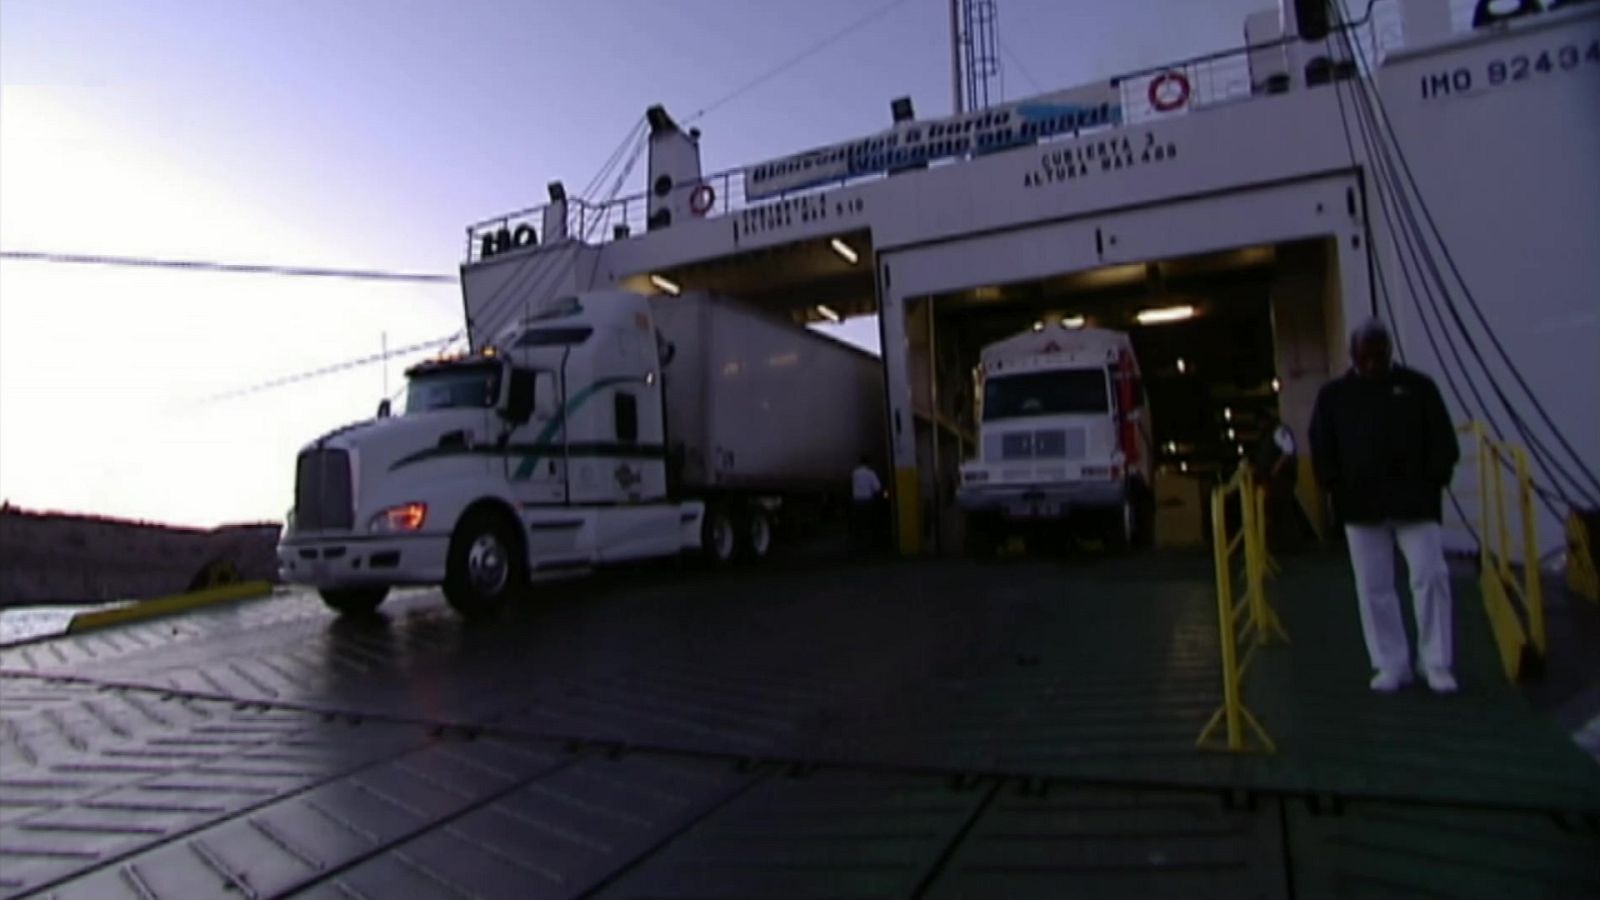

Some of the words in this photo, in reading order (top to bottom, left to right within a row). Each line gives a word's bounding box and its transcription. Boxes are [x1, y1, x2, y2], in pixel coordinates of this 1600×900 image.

[1420, 66, 1471, 99] IMO
[1041, 136, 1131, 169] CUBIERTA
[1023, 163, 1088, 188] ALTURA
[1101, 151, 1134, 171] MAX
